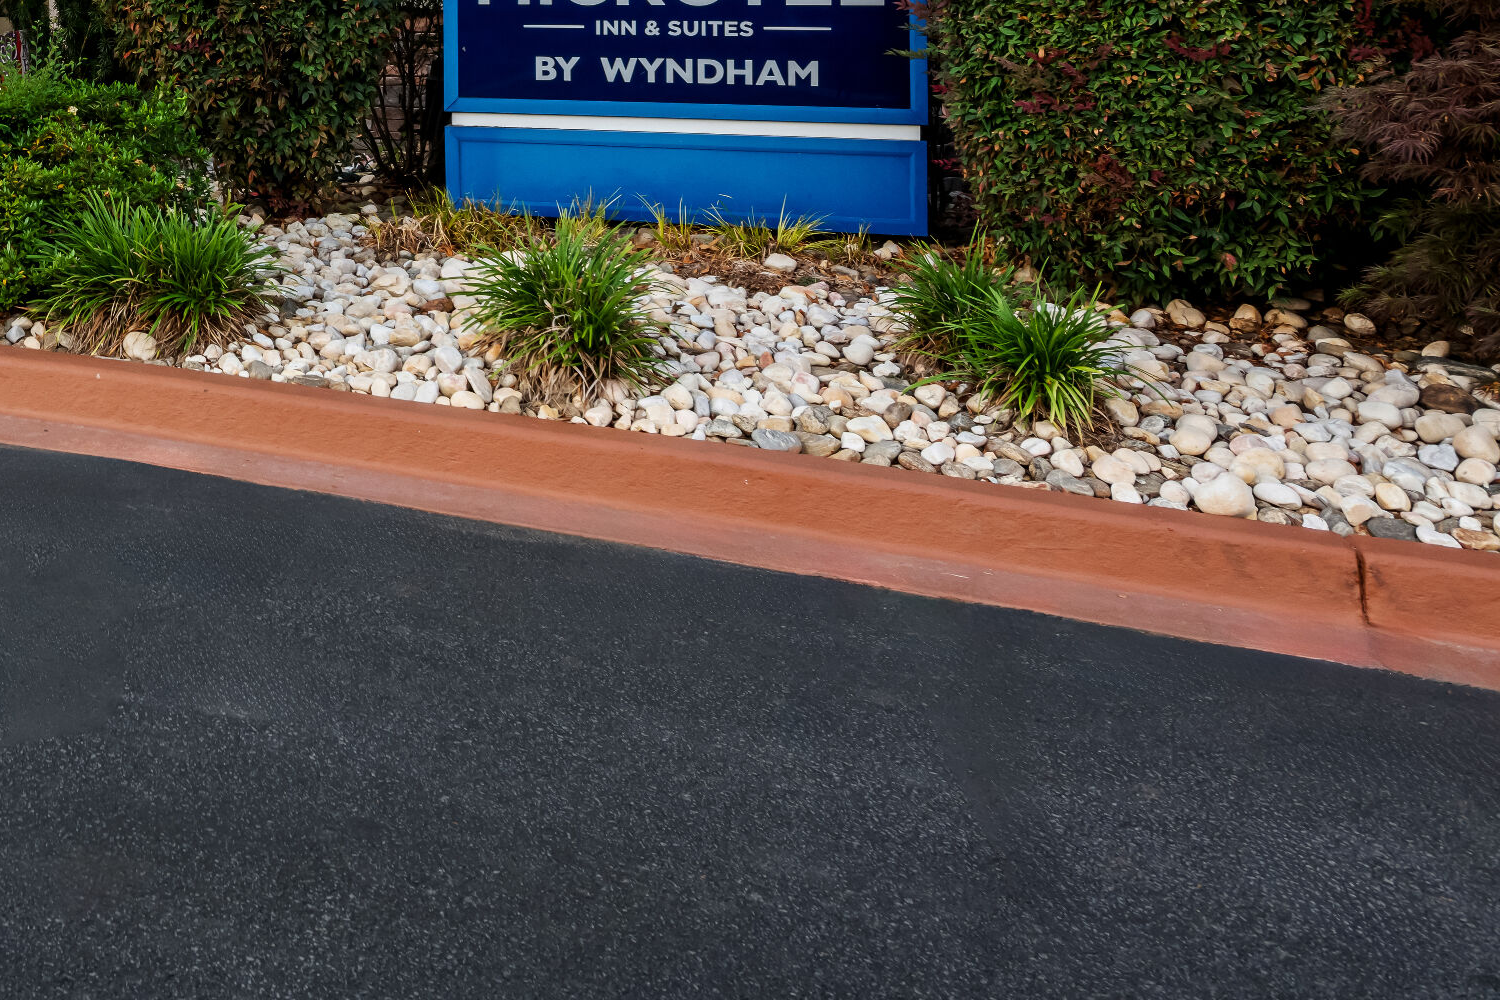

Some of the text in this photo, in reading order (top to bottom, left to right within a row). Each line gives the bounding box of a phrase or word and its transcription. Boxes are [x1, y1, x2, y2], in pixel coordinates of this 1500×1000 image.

[595, 20, 754, 37] INN & SUITES
[535, 55, 819, 87] BY WYNDHAM
